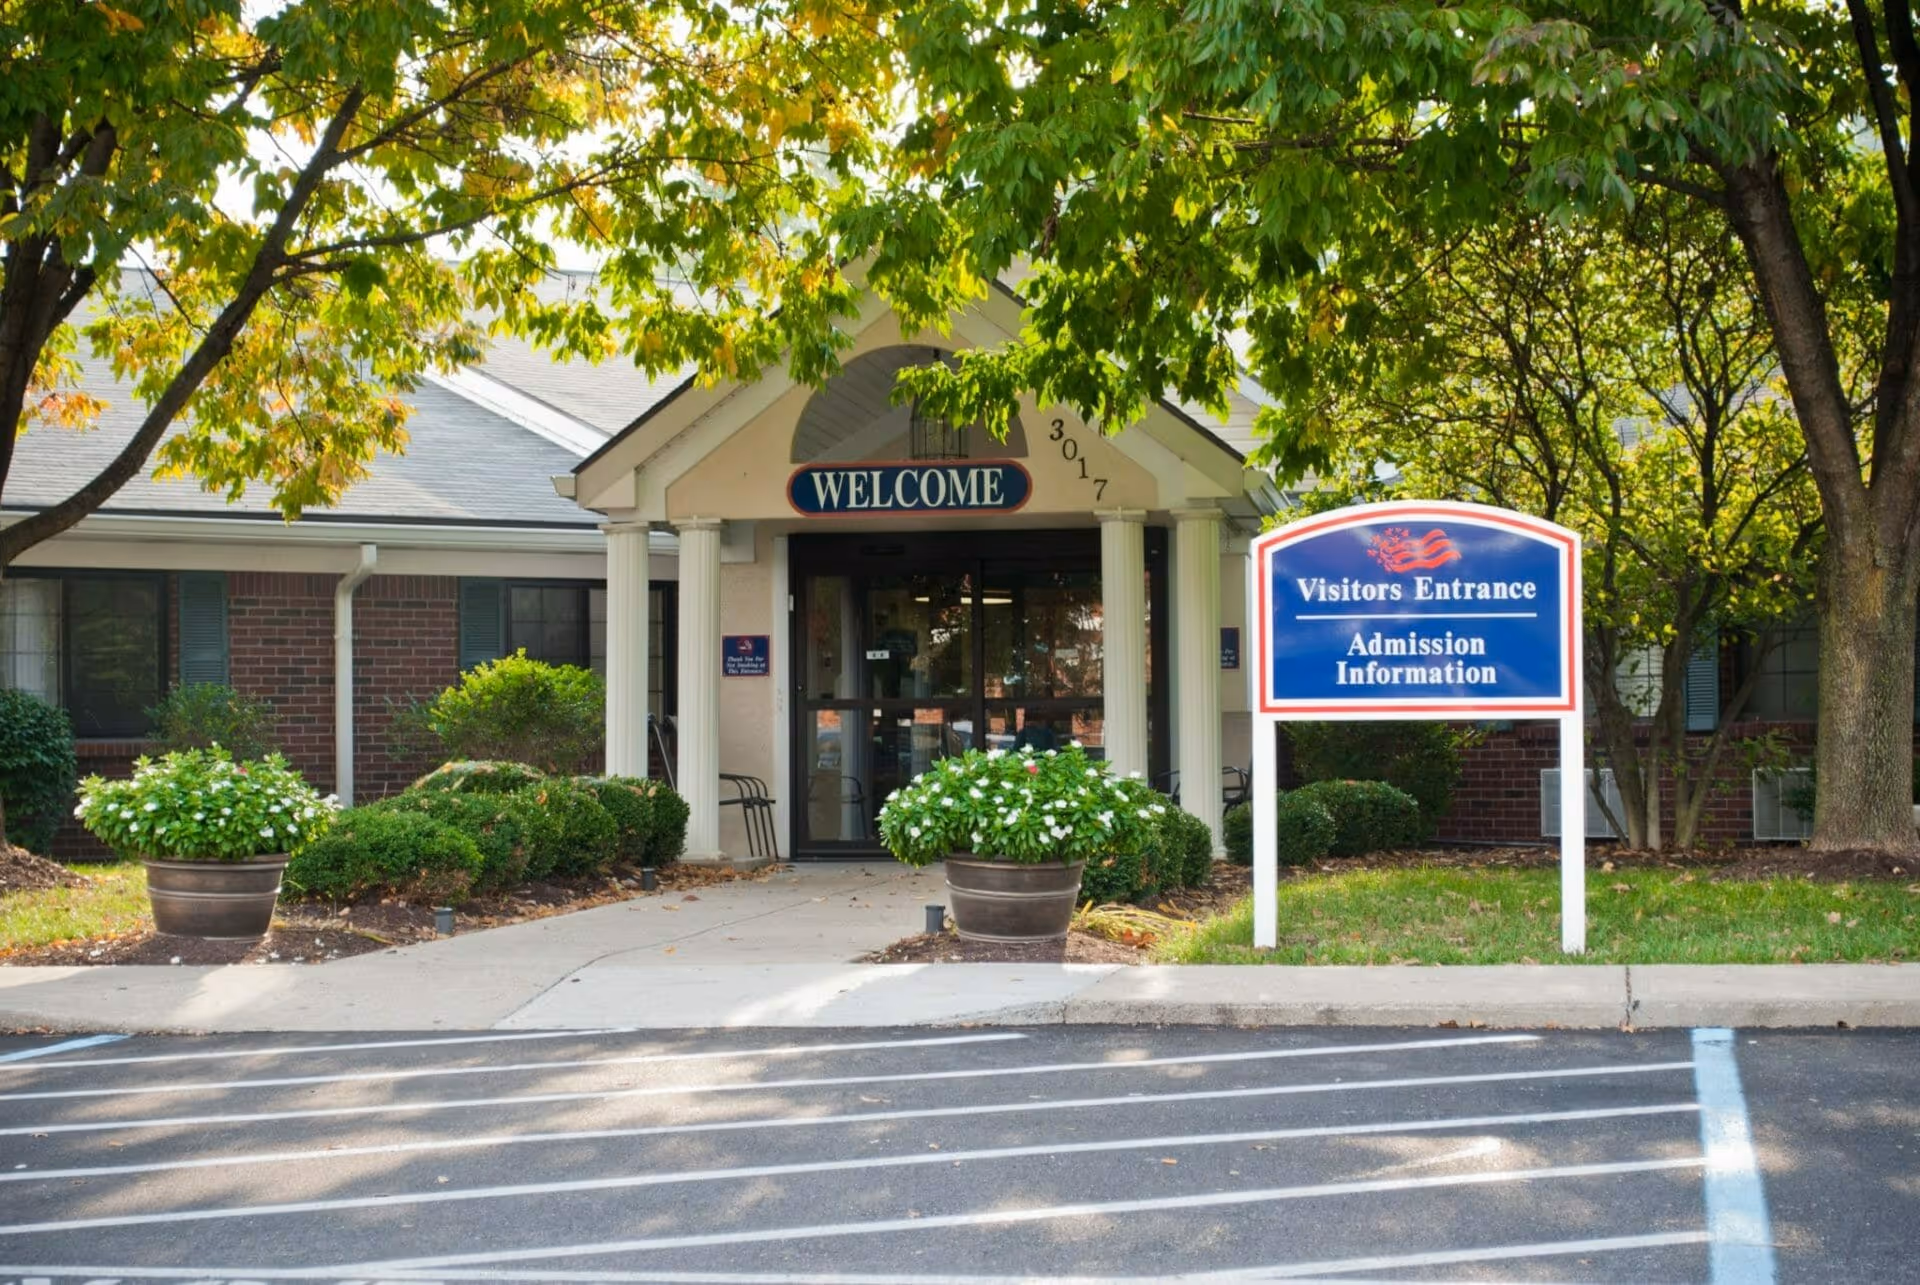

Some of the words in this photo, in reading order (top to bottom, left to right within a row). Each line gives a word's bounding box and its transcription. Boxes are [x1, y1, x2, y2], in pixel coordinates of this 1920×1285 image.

[1050, 418, 1107, 502] 3017
[811, 468, 1004, 510] WELCOME
[1297, 578, 1402, 601] Visitors
[1414, 576, 1536, 600] Entrance
[1347, 631, 1485, 656] Admission
[1336, 660, 1497, 685] Information
